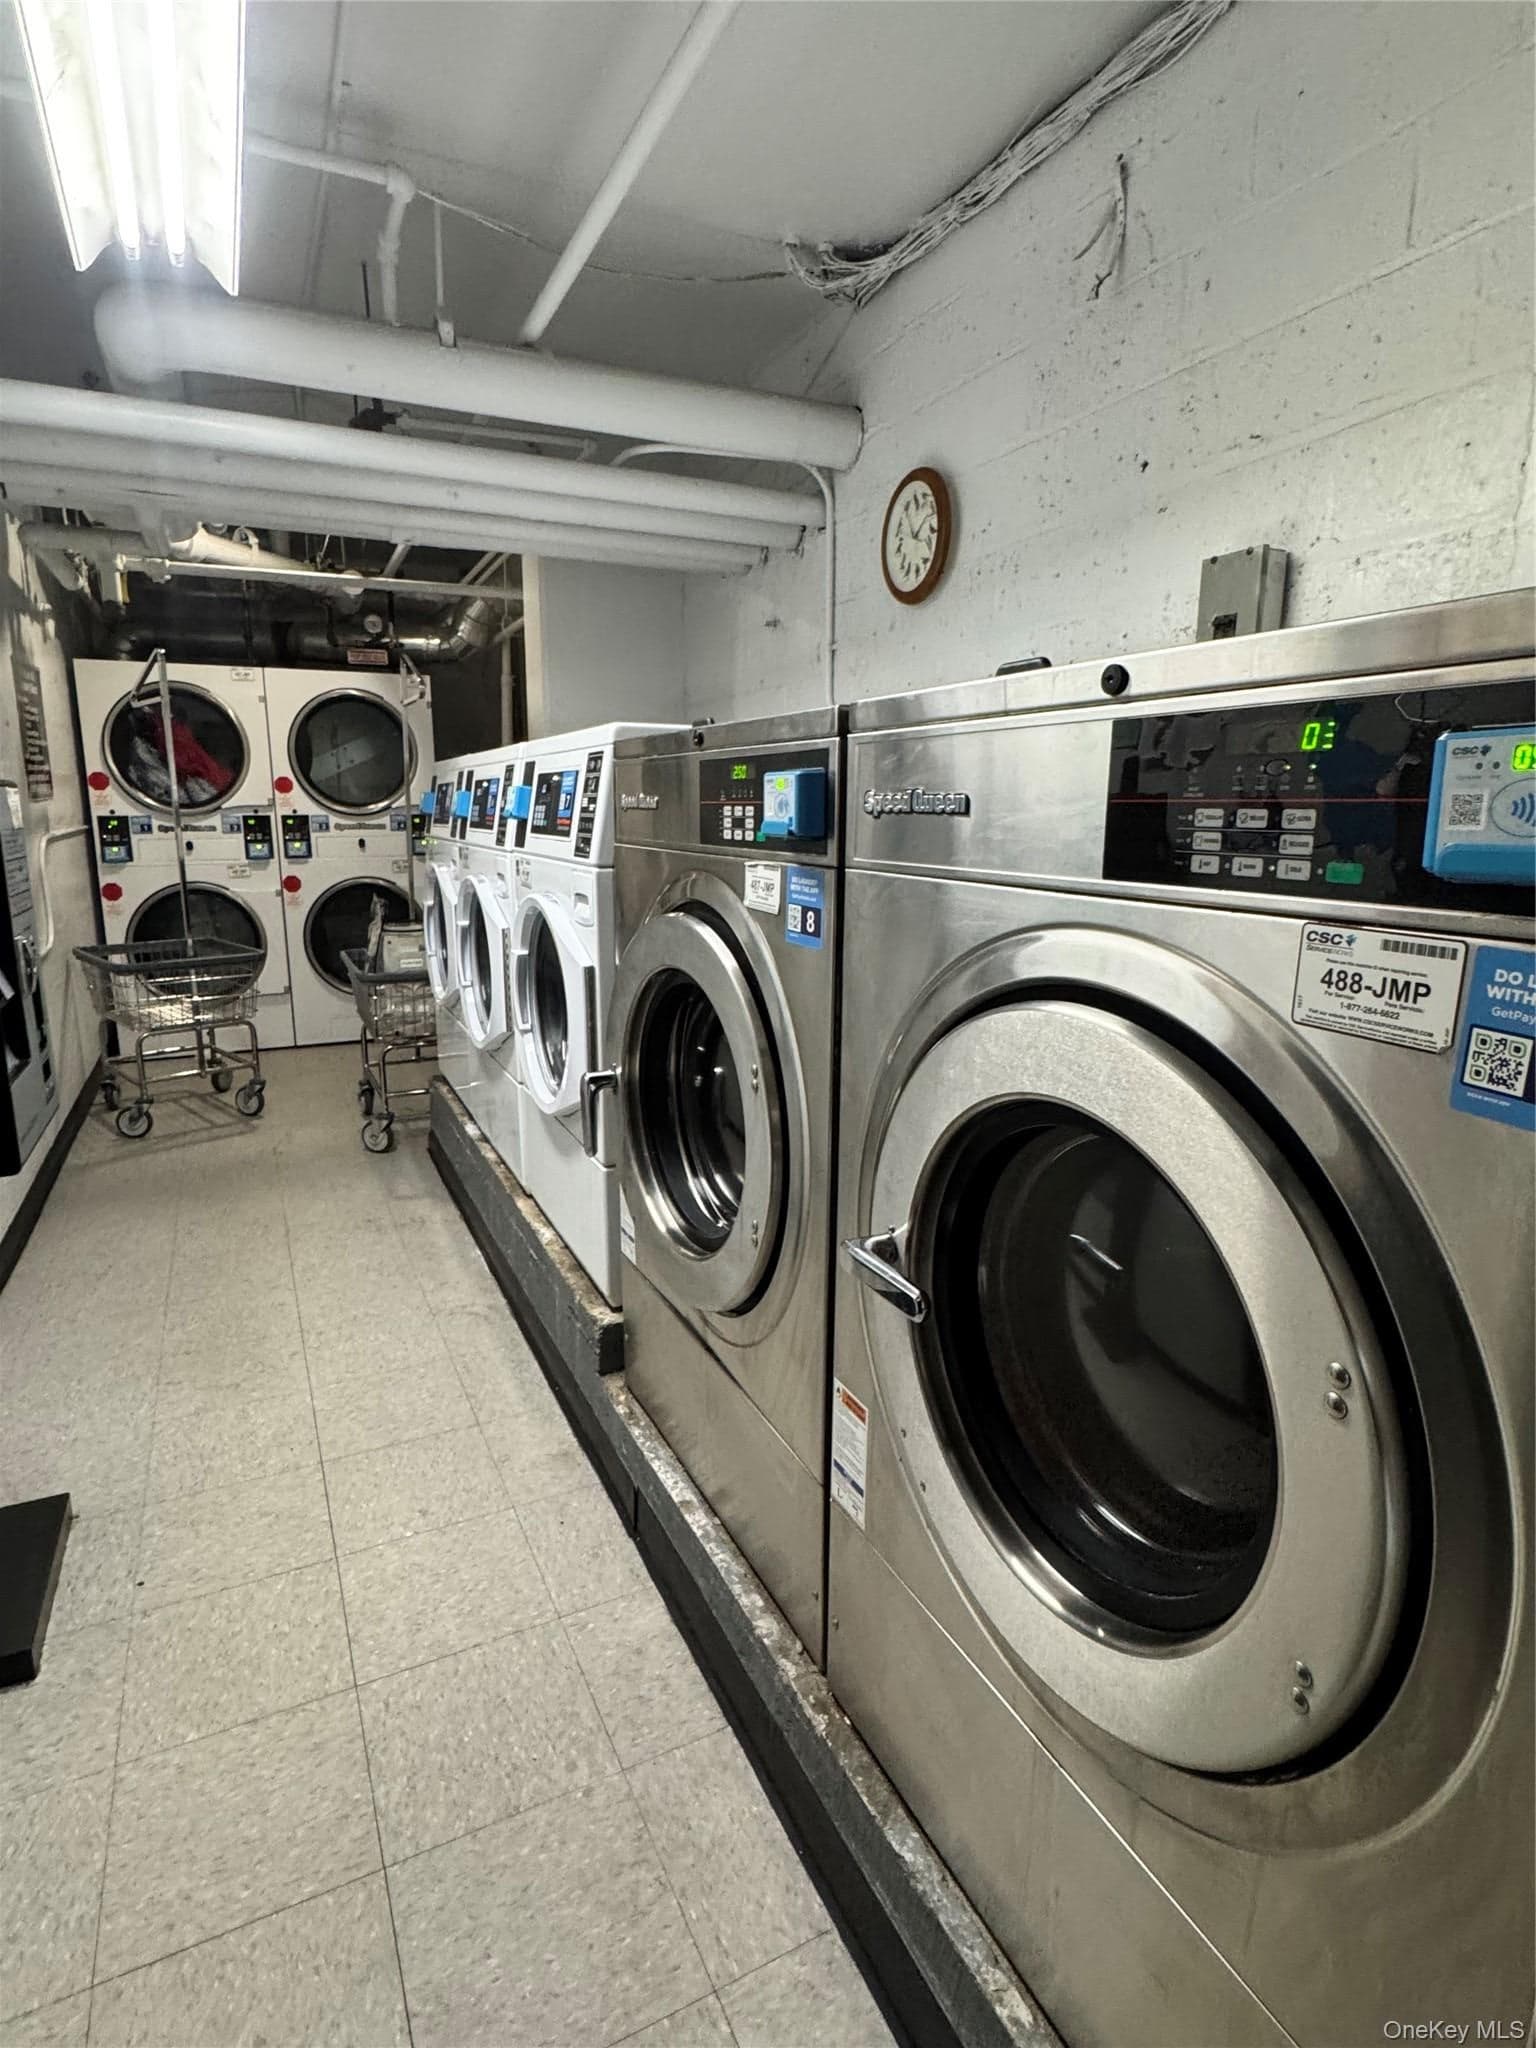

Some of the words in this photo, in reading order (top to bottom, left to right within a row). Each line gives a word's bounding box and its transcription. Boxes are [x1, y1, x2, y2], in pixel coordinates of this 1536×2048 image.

[1451, 745, 1480, 756] CSC
[863, 788, 912, 818] Speed
[911, 787, 971, 816] Queen
[806, 910, 816, 934] 8
[1306, 930, 1344, 946] CSC
[1320, 968, 1432, 1005] 488-JMP
[1493, 968, 1523, 986] DO
[1486, 983, 1536, 1007] WITH
